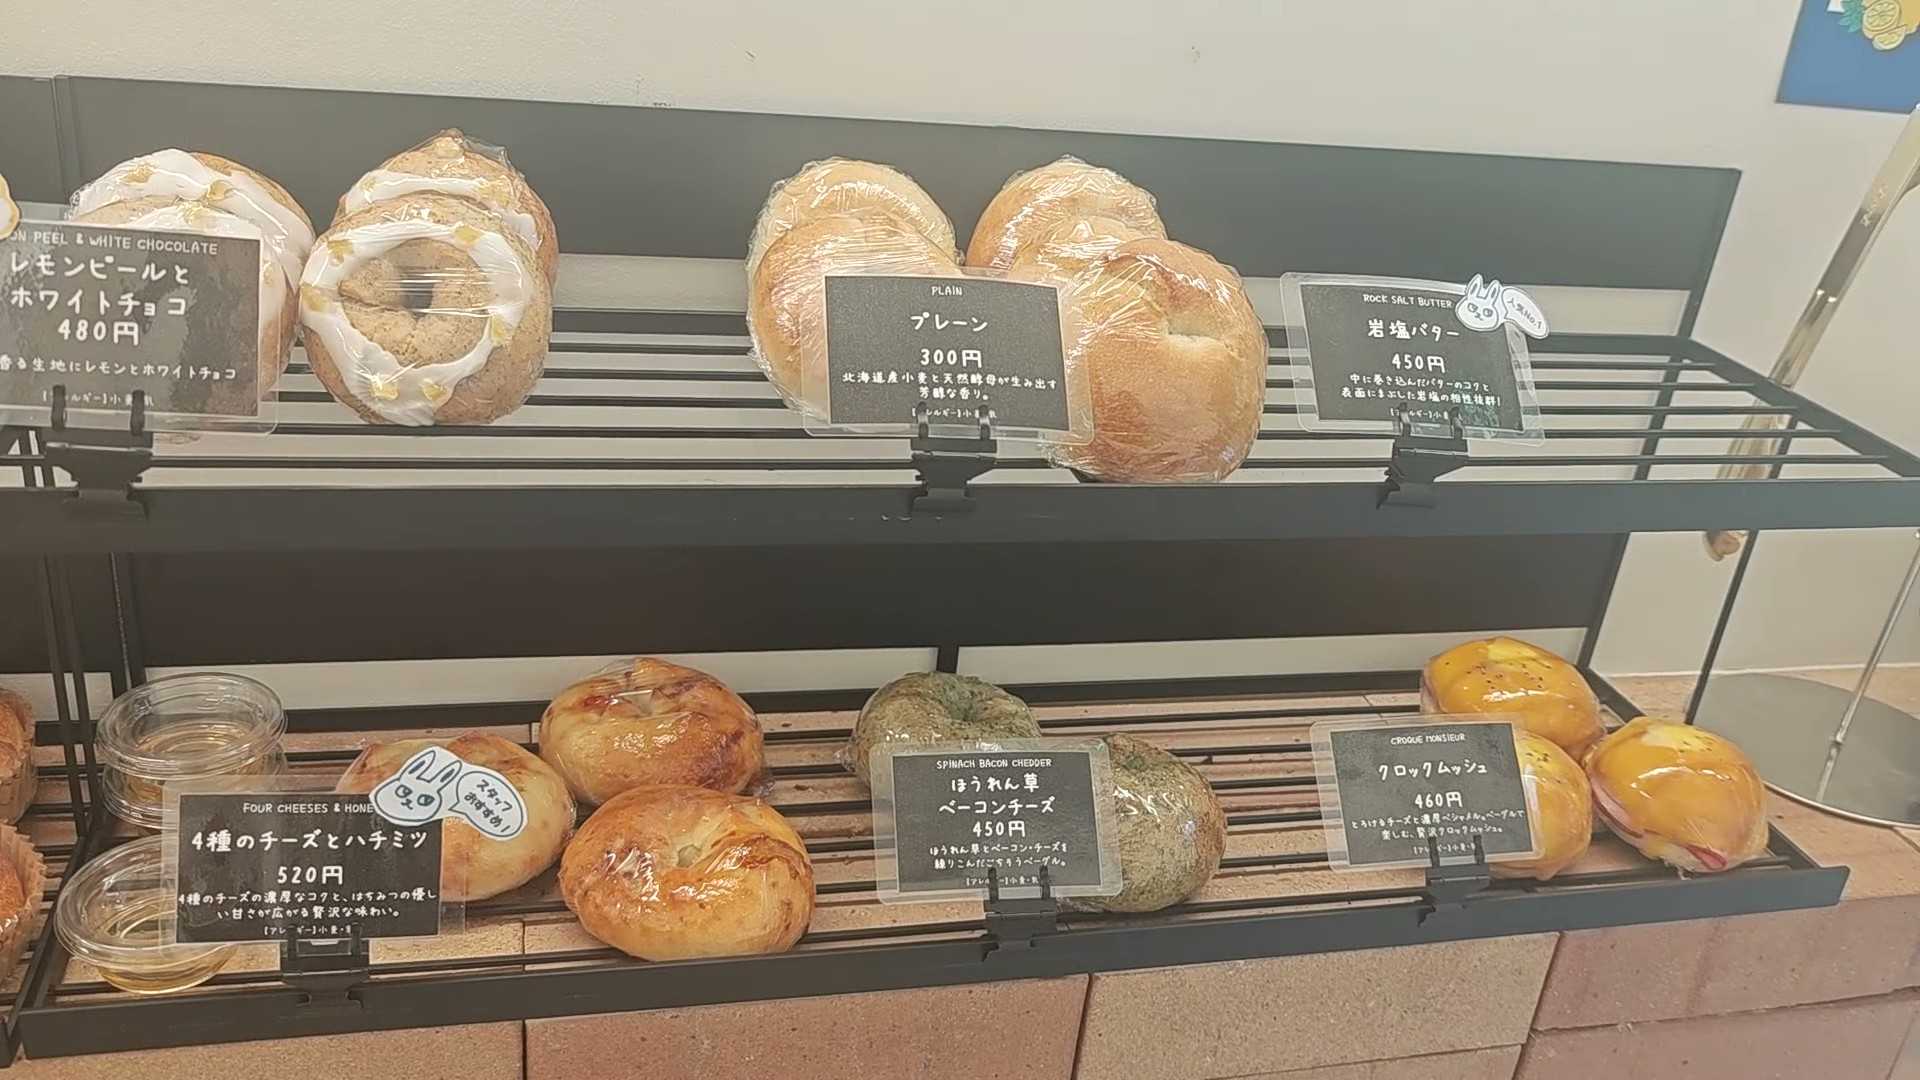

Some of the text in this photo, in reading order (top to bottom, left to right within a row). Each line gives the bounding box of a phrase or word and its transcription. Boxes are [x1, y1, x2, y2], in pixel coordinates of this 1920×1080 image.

[33, 231, 68, 245] PEEL
[76, 232, 84, 244] &
[137, 238, 219, 255] CHOCOLATE
[931, 286, 963, 296] PLAIN
[11, 286, 187, 317] ホワイトチョコ
[1363, 294, 1452, 309] ROCK SALT BUTTER
[58, 319, 139, 345] 480円
[910, 312, 988, 332] プレーン
[1367, 318, 1460, 343] 岩塩バター
[920, 349, 982, 368] 300円
[1392, 353, 1446, 373] 450円
[1390, 735, 1423, 745] CROQUE
[936, 758, 1052, 769] SPINACH BACON CHEDDER
[1378, 758, 1488, 781] クロックムッシュ
[951, 772, 1040, 793] ほうれん草
[476, 779, 513, 812] スタッフ
[1414, 791, 1463, 809] 460円
[243, 802, 373, 814] FOUR CHEESES & HONE
[938, 796, 1056, 816] ベーコンチーズ
[972, 820, 1026, 838] 450円
[191, 828, 427, 853] 4種のチーズとハチミツ
[277, 865, 344, 885] 520円
